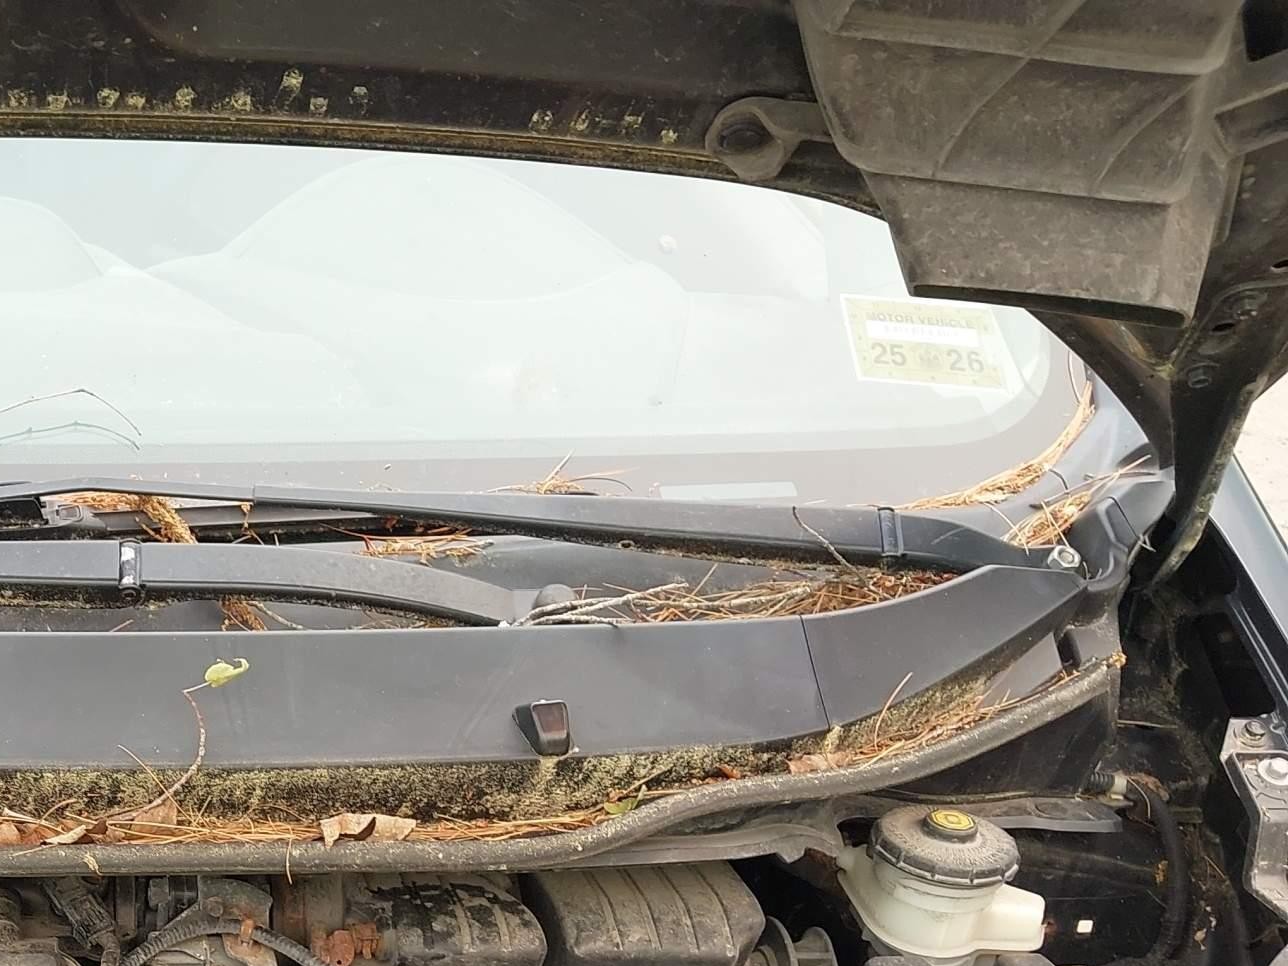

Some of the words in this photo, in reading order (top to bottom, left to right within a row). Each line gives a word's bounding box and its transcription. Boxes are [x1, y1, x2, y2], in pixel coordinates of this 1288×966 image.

[866, 311, 915, 324] MOTOR
[917, 315, 976, 329] VEHICLE
[871, 342, 906, 367] 25
[946, 348, 985, 374] 26
